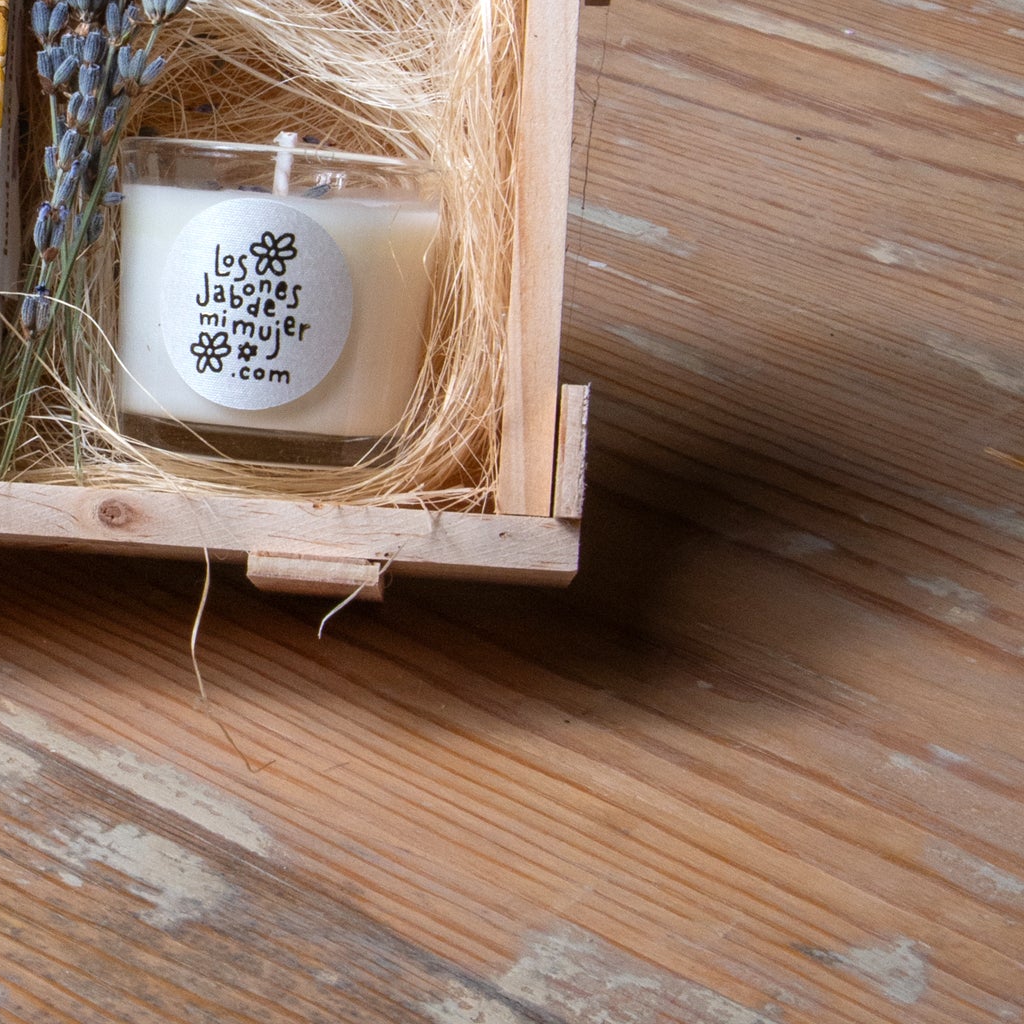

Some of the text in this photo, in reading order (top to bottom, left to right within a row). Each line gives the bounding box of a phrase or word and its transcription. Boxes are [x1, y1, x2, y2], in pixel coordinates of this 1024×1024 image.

[215, 243, 248, 282] Los
[196, 272, 302, 309] Jabones
[246, 297, 276, 317] de
[199, 309, 311, 360] mi mujer
[231, 366, 291, 384] .com
